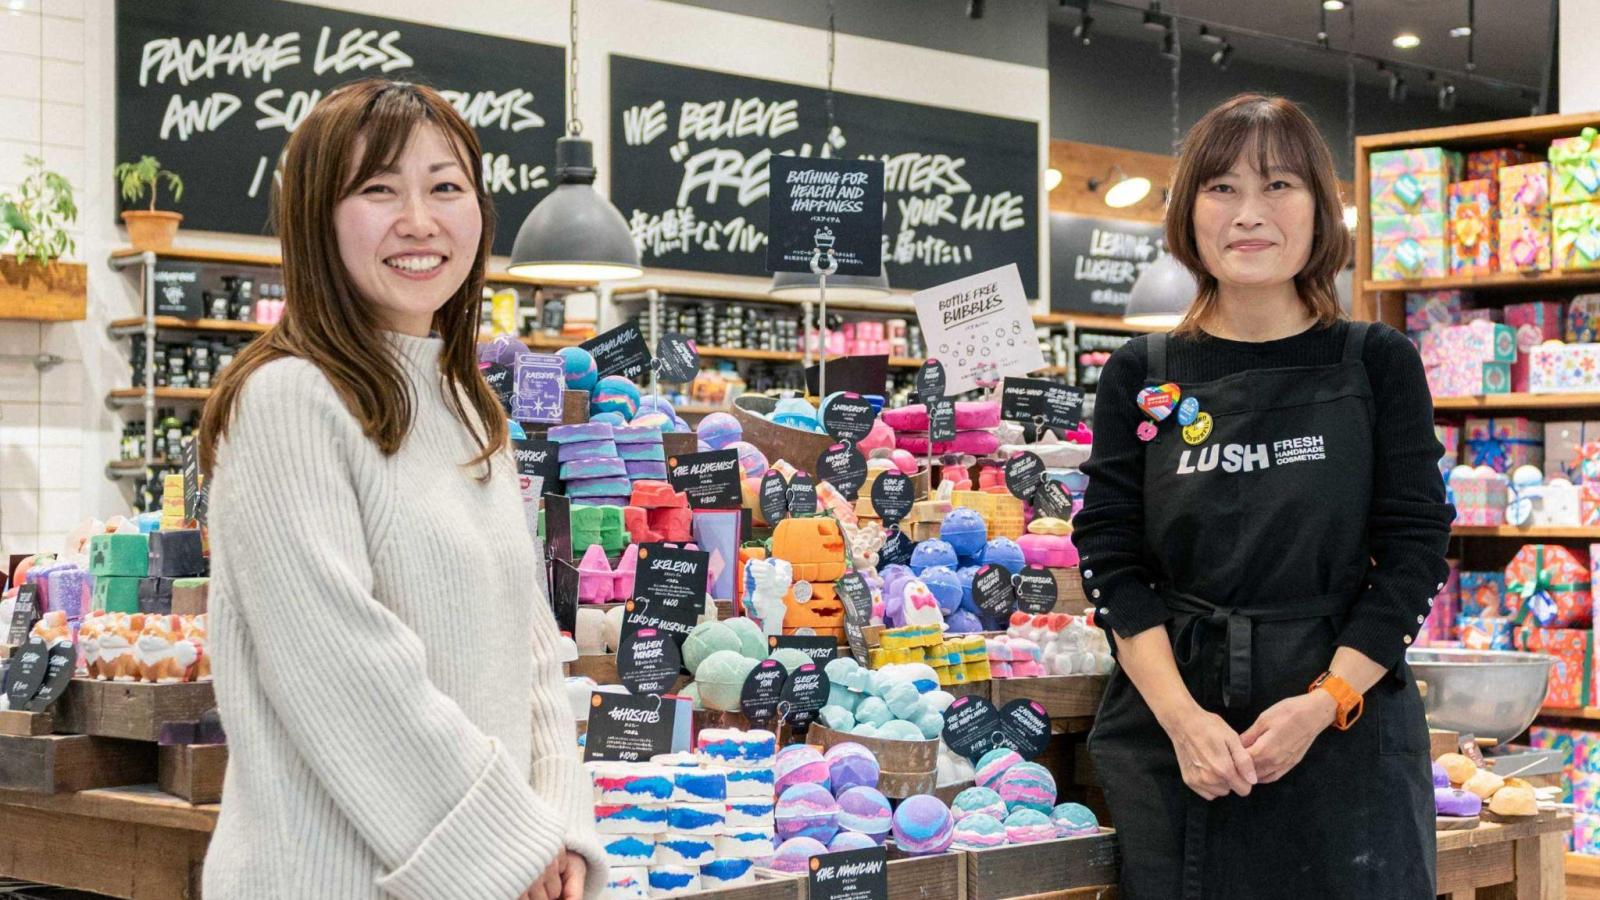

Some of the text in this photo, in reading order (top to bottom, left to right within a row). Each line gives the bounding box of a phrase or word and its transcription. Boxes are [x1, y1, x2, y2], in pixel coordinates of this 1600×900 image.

[140, 26, 413, 87] PACKAGE LESS
[160, 93, 242, 141] AND
[623, 97, 799, 145] WE BELIEVE
[786, 170, 868, 184] BATHING FOR
[790, 184, 864, 199] HEALTH AND
[791, 198, 863, 213] HAPPINESS
[898, 191, 1025, 231] YOUR LIFE
[938, 281, 999, 311] BOTTLE FREE
[942, 294, 1003, 324] BUBBLES
[1273, 435, 1324, 452] FRESH
[1275, 445, 1325, 459] HANDMADE
[1176, 443, 1270, 474] LUSH
[1276, 452, 1326, 465] COSMETICS
[672, 459, 737, 478] THE ALCHEMIST
[650, 559, 698, 575] SKELETON
[627, 613, 696, 635] LORD OF MISRULE
[632, 640, 664, 651] GOLDEN
[633, 649, 664, 660] WONDER
[794, 674, 820, 684] SLEEPY
[816, 861, 883, 882] THE MAGICIAN
